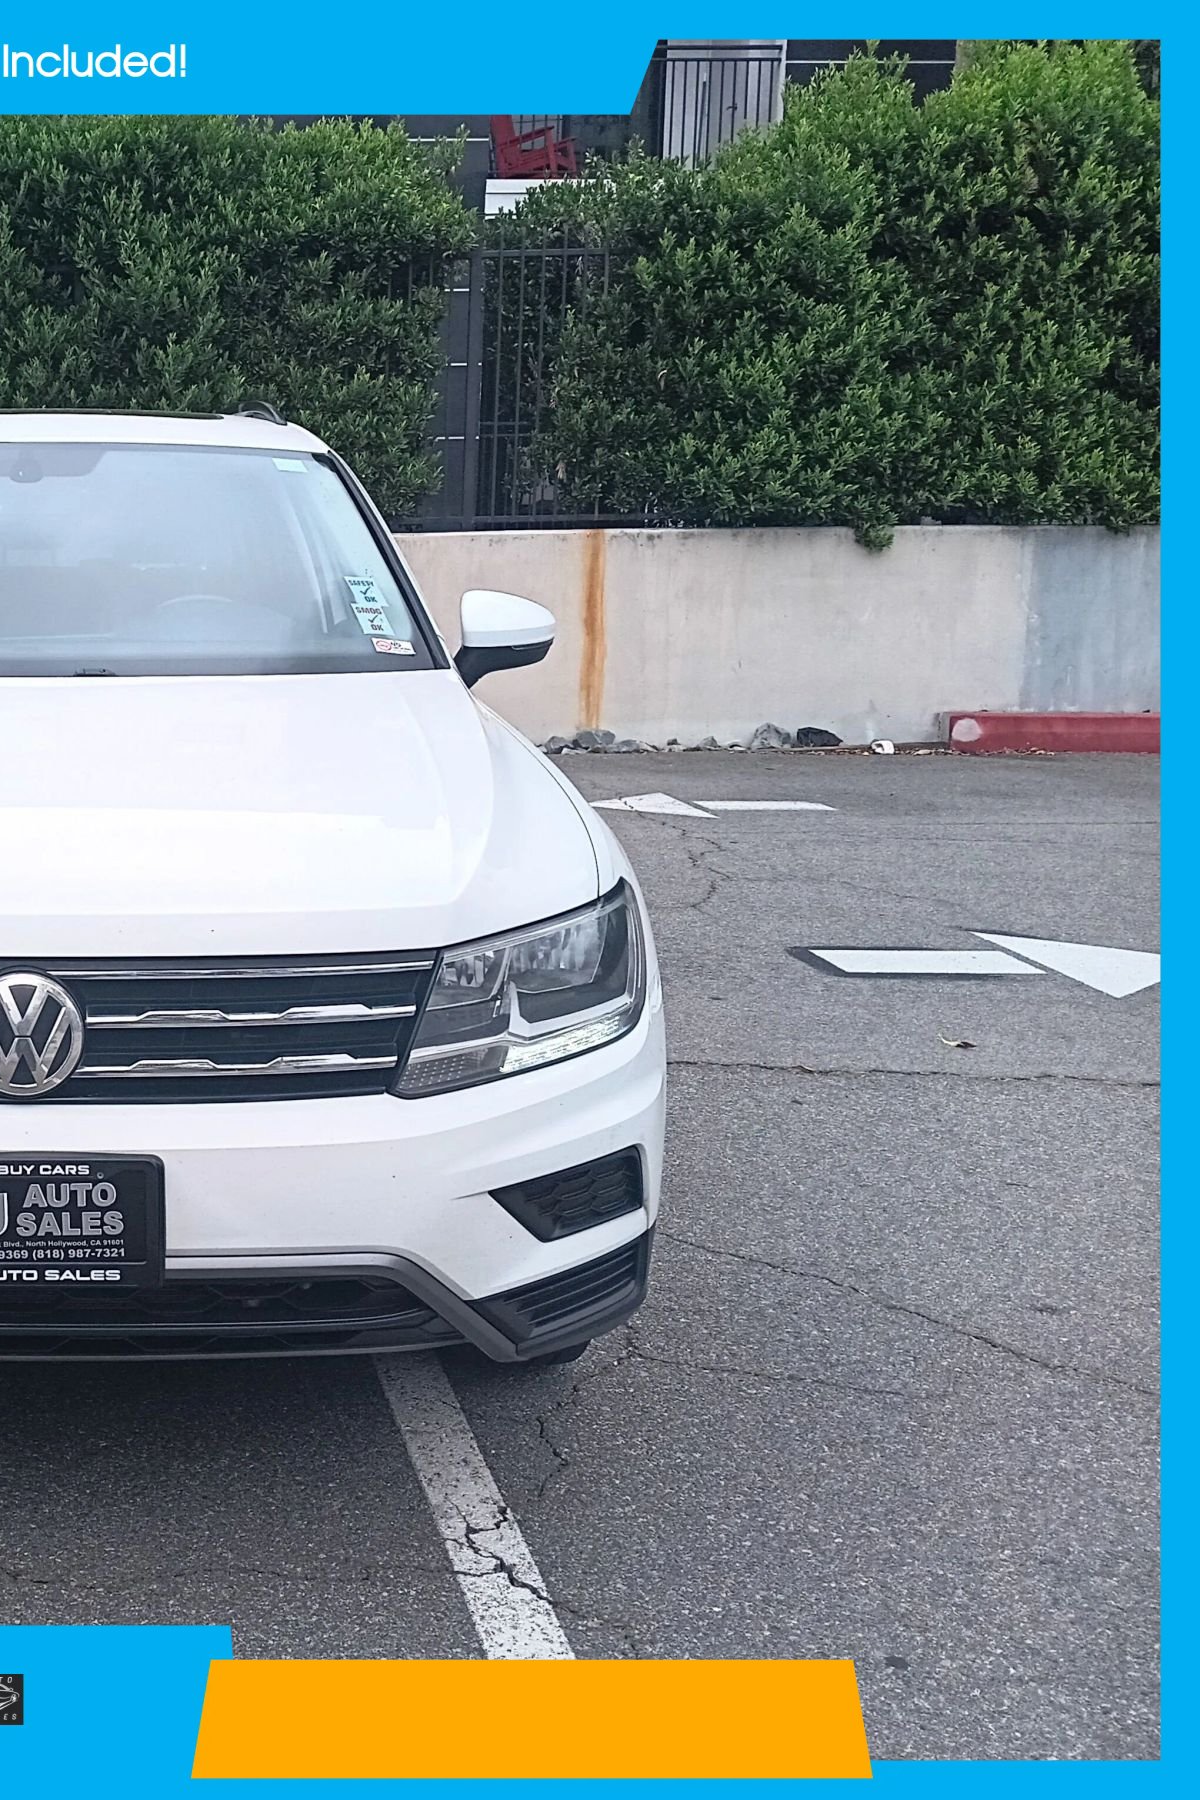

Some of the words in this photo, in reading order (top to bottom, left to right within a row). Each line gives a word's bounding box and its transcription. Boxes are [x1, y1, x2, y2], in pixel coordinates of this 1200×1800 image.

[355, 606, 382, 615] SMOG
[39, 1165, 90, 1175] CARS
[22, 1182, 117, 1208] AUTO
[15, 1211, 124, 1237] SALES
[48, 1239, 89, 1248] Hollywood,
[32, 1249, 65, 1260] (818)
[68, 1247, 125, 1258] 987-7321
[44, 1269, 121, 1281] SALES
